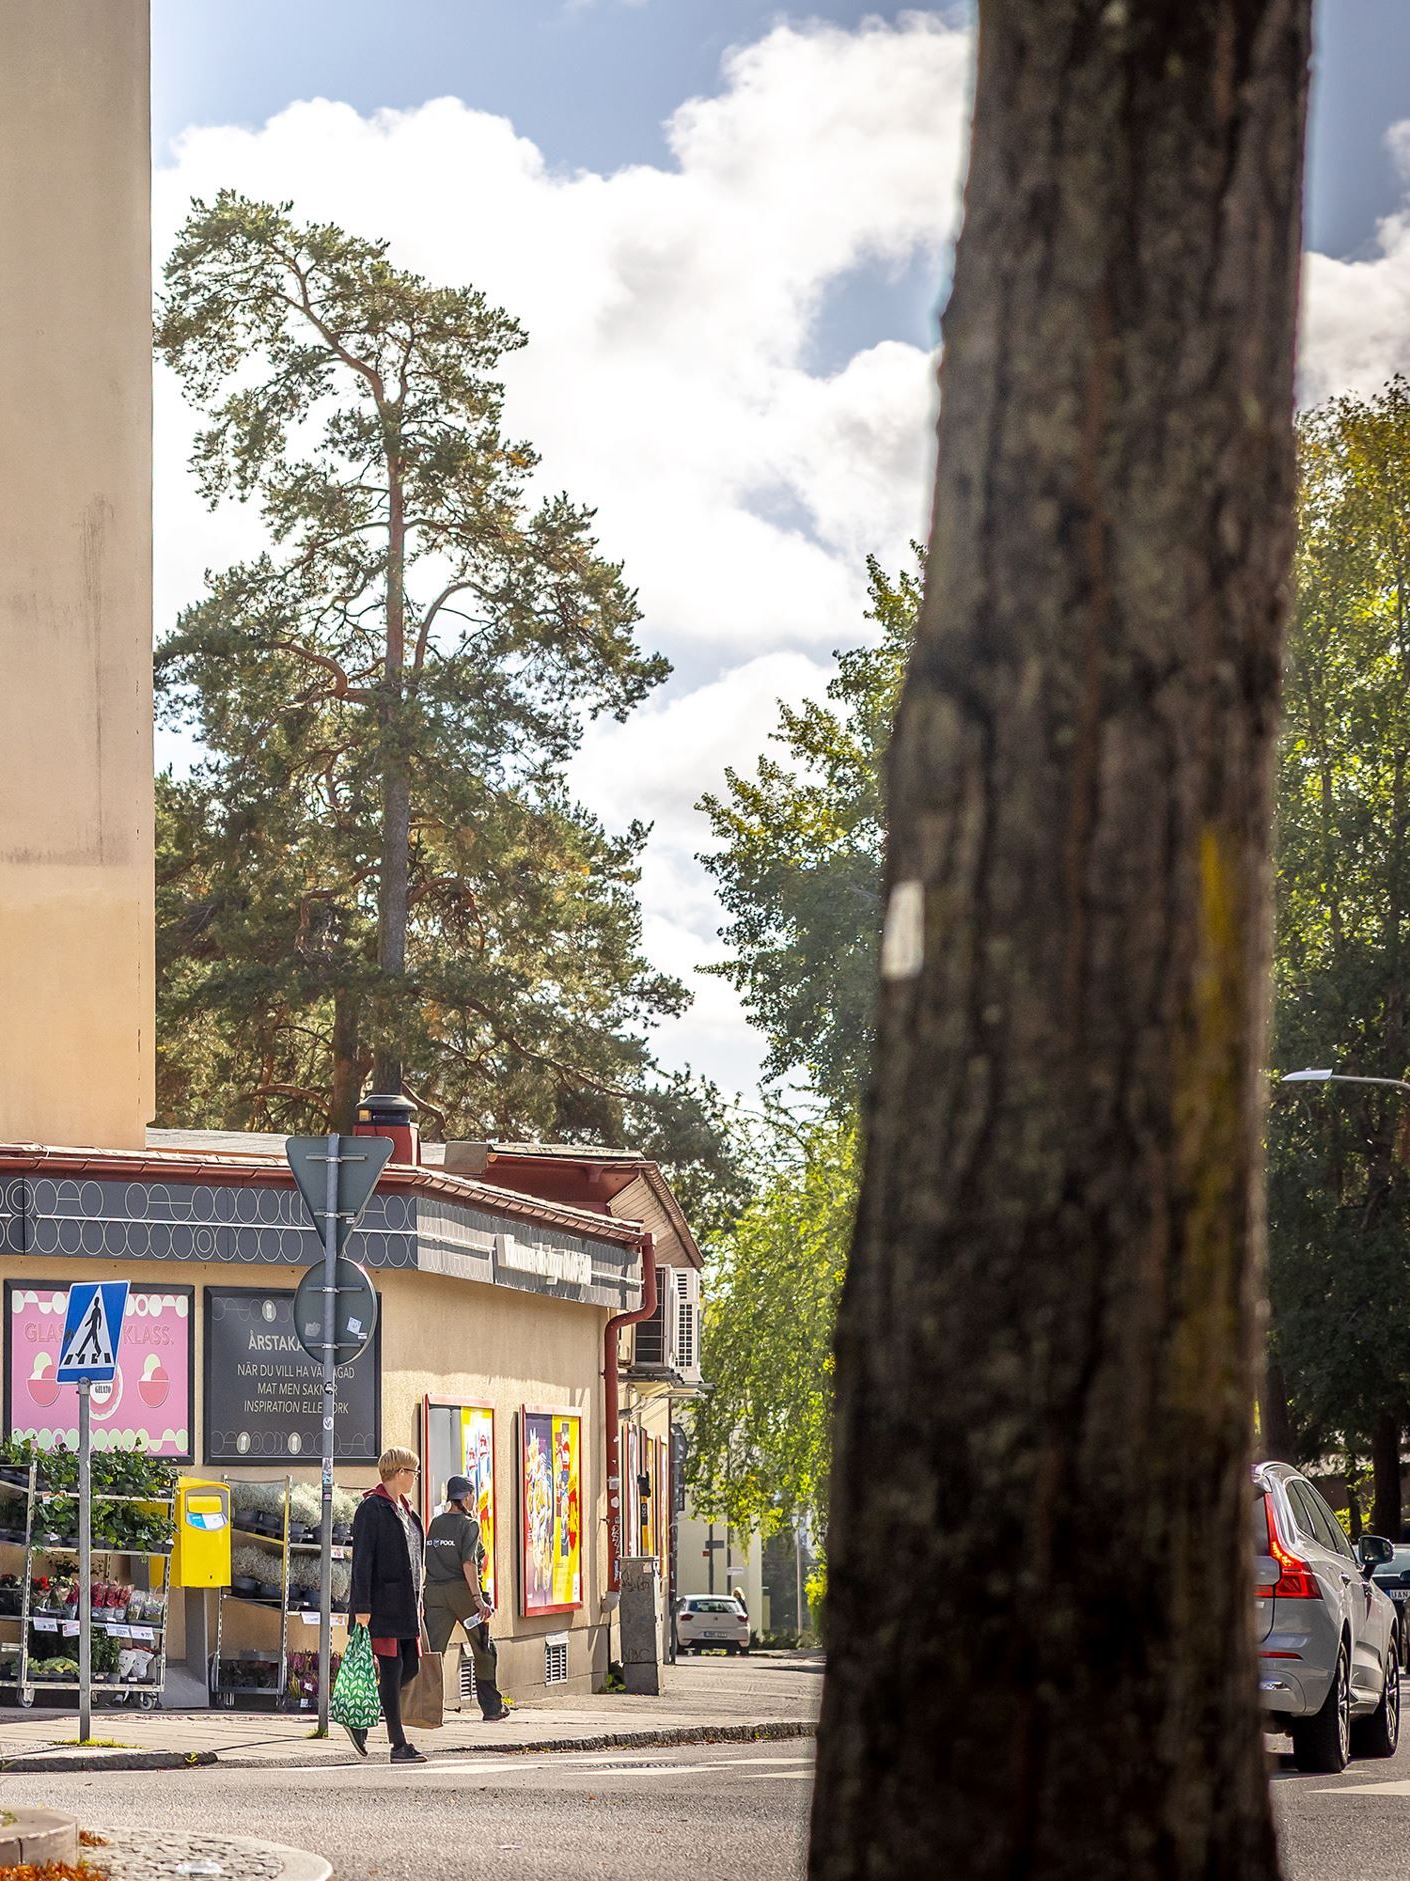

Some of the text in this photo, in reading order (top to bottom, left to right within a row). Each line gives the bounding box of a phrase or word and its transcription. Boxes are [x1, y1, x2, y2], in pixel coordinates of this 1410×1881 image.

[24, 1321, 64, 1343] GLAS
[248, 1329, 305, 1352] ÅRSTAKA
[237, 1361, 258, 1376] NÄR
[259, 1364, 274, 1376] DU
[275, 1364, 294, 1377] VILL
[296, 1365, 309, 1377] HA
[257, 1382, 338, 1396] MAT MEN SAKNR
[244, 1400, 300, 1413] INSPIRATION
[302, 1401, 323, 1414] ELLE
